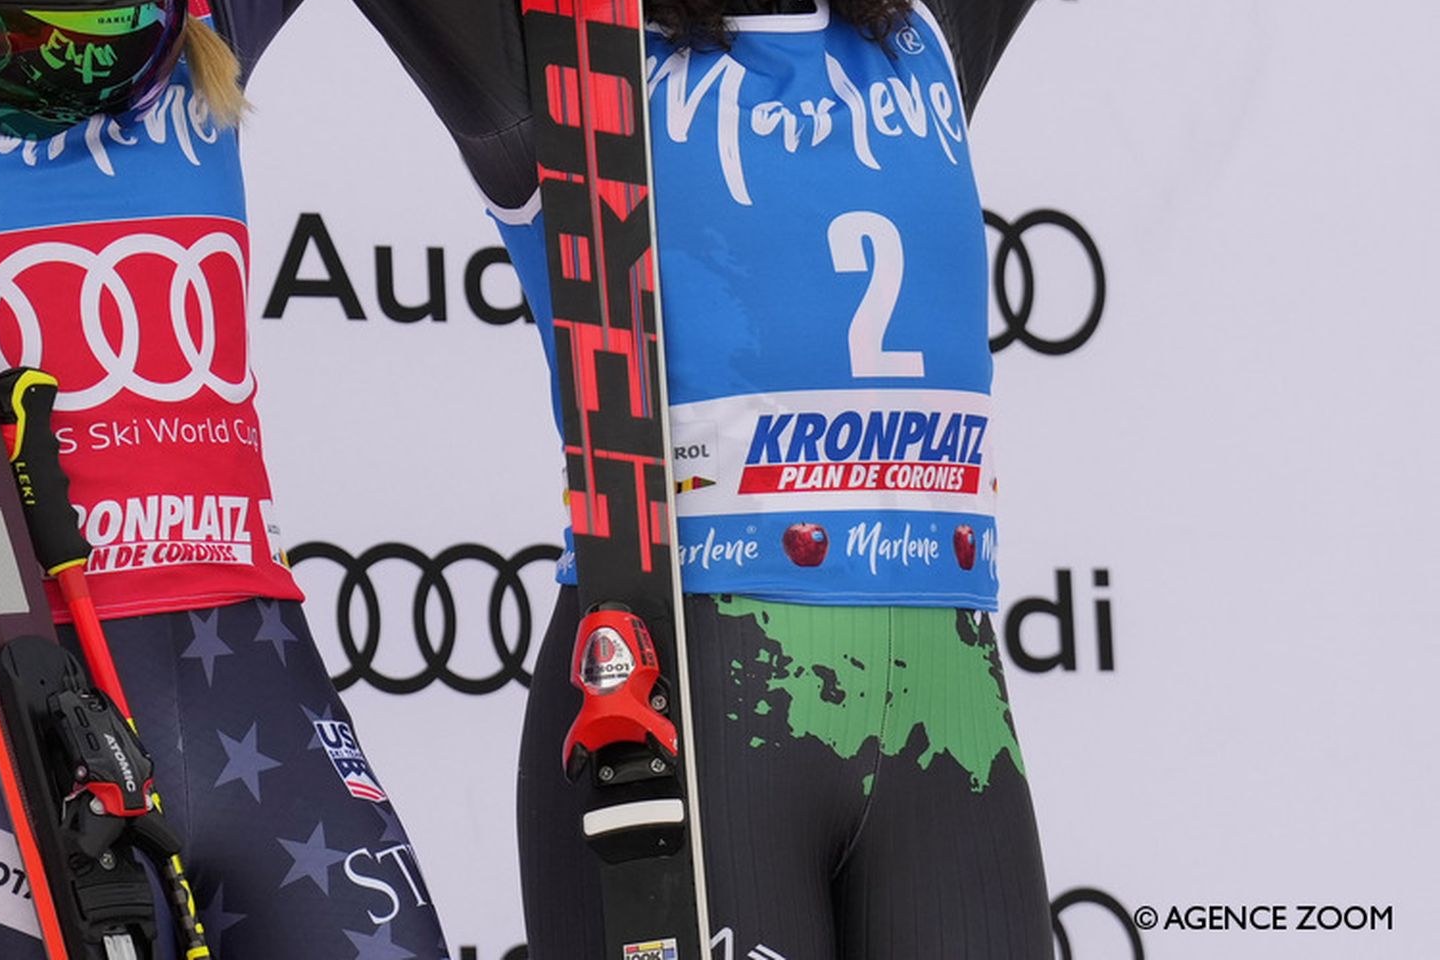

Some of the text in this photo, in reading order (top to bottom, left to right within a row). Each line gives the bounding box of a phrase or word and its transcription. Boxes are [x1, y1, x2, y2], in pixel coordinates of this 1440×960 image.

[647, 48, 963, 206] Marlene
[261, 211, 538, 326] Aud
[827, 211, 926, 378] 2
[88, 418, 140, 450] Ski
[145, 417, 230, 444] World
[745, 411, 988, 465] KRONPLATZ
[14, 462, 37, 505] LEKI
[777, 464, 965, 491] PLAN DE CORONES
[115, 545, 148, 569] DE
[846, 520, 940, 575] Marlene
[104, 733, 137, 793] ATOMIC
[316, 723, 356, 750] US
